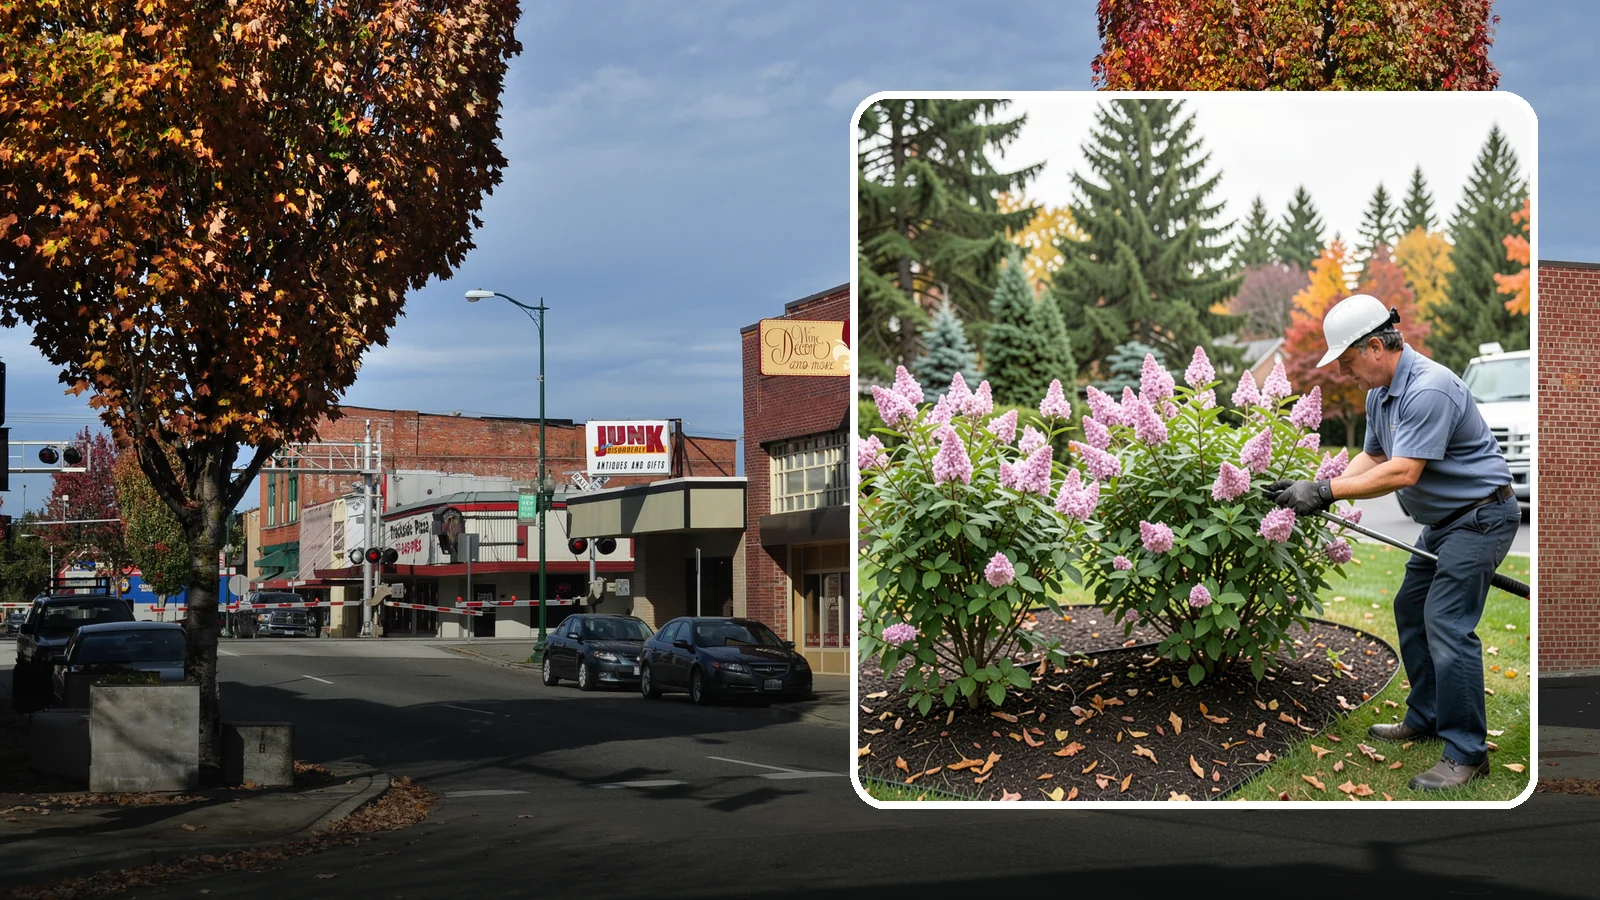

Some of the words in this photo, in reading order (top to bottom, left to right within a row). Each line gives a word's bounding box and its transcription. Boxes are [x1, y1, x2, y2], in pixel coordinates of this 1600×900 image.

[596, 425, 665, 457] JUNK
[607, 446, 646, 454] DISORDERLY
[596, 460, 628, 470] ANTIQUES
[631, 460, 644, 470] AND
[647, 460, 666, 470] GIFTS
